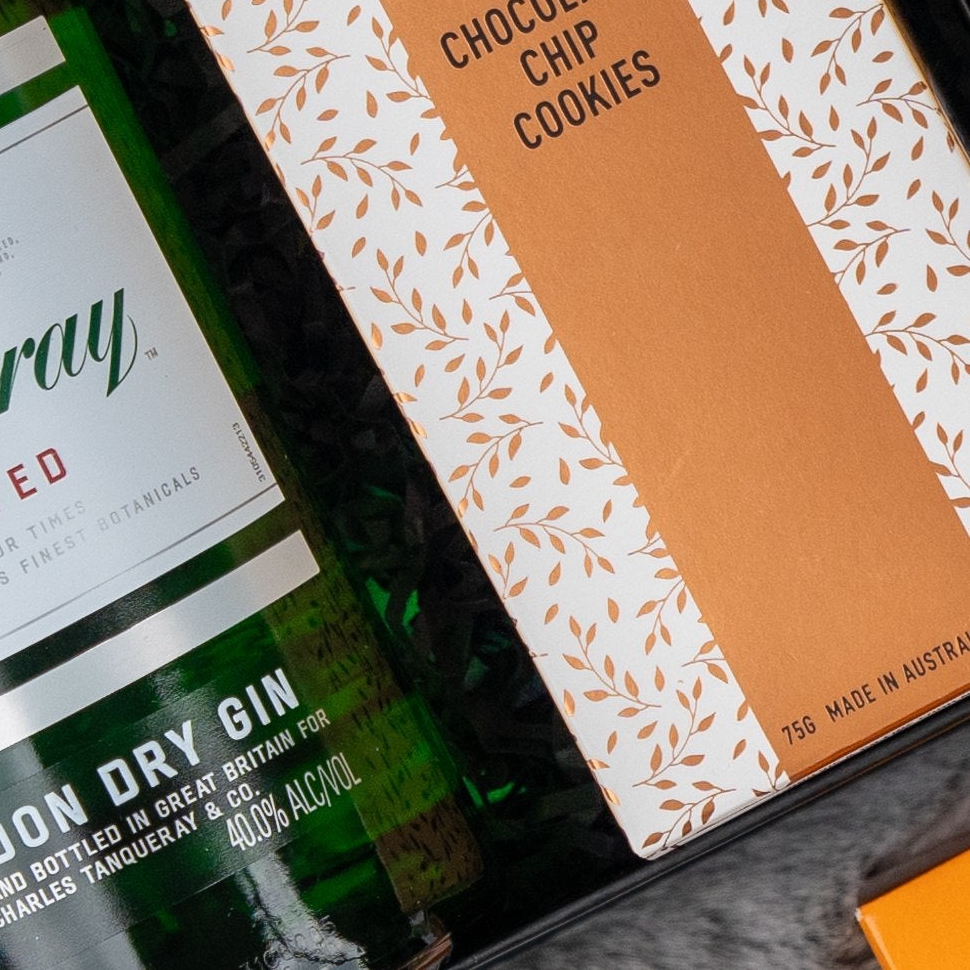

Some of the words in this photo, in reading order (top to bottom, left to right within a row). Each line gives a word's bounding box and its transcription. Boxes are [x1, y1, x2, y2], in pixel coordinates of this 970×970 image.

[513, 50, 661, 150] COOKIES
[519, 19, 598, 87] CHIP
[19, 529, 87, 575] FINEST
[96, 466, 201, 532] BOTANICALS
[27, 500, 87, 540] TIMES
[96, 720, 200, 807] DRY
[217, 668, 300, 741] GIN
[781, 715, 817, 745] 75G
[825, 683, 877, 722] MADE
[876, 671, 900, 695] IN
[30, 824, 122, 883] BOTTLED
[126, 809, 151, 835] IN
[155, 772, 217, 819] GREAT
[222, 729, 297, 782] BRITAIN
[296, 708, 331, 739] FOR
[80, 812, 198, 885] TANQUERAY
[204, 802, 224, 821] &
[227, 783, 261, 808] CO.
[226, 793, 290, 851] 40.0%
[285, 752, 362, 821] ALC/VOL
